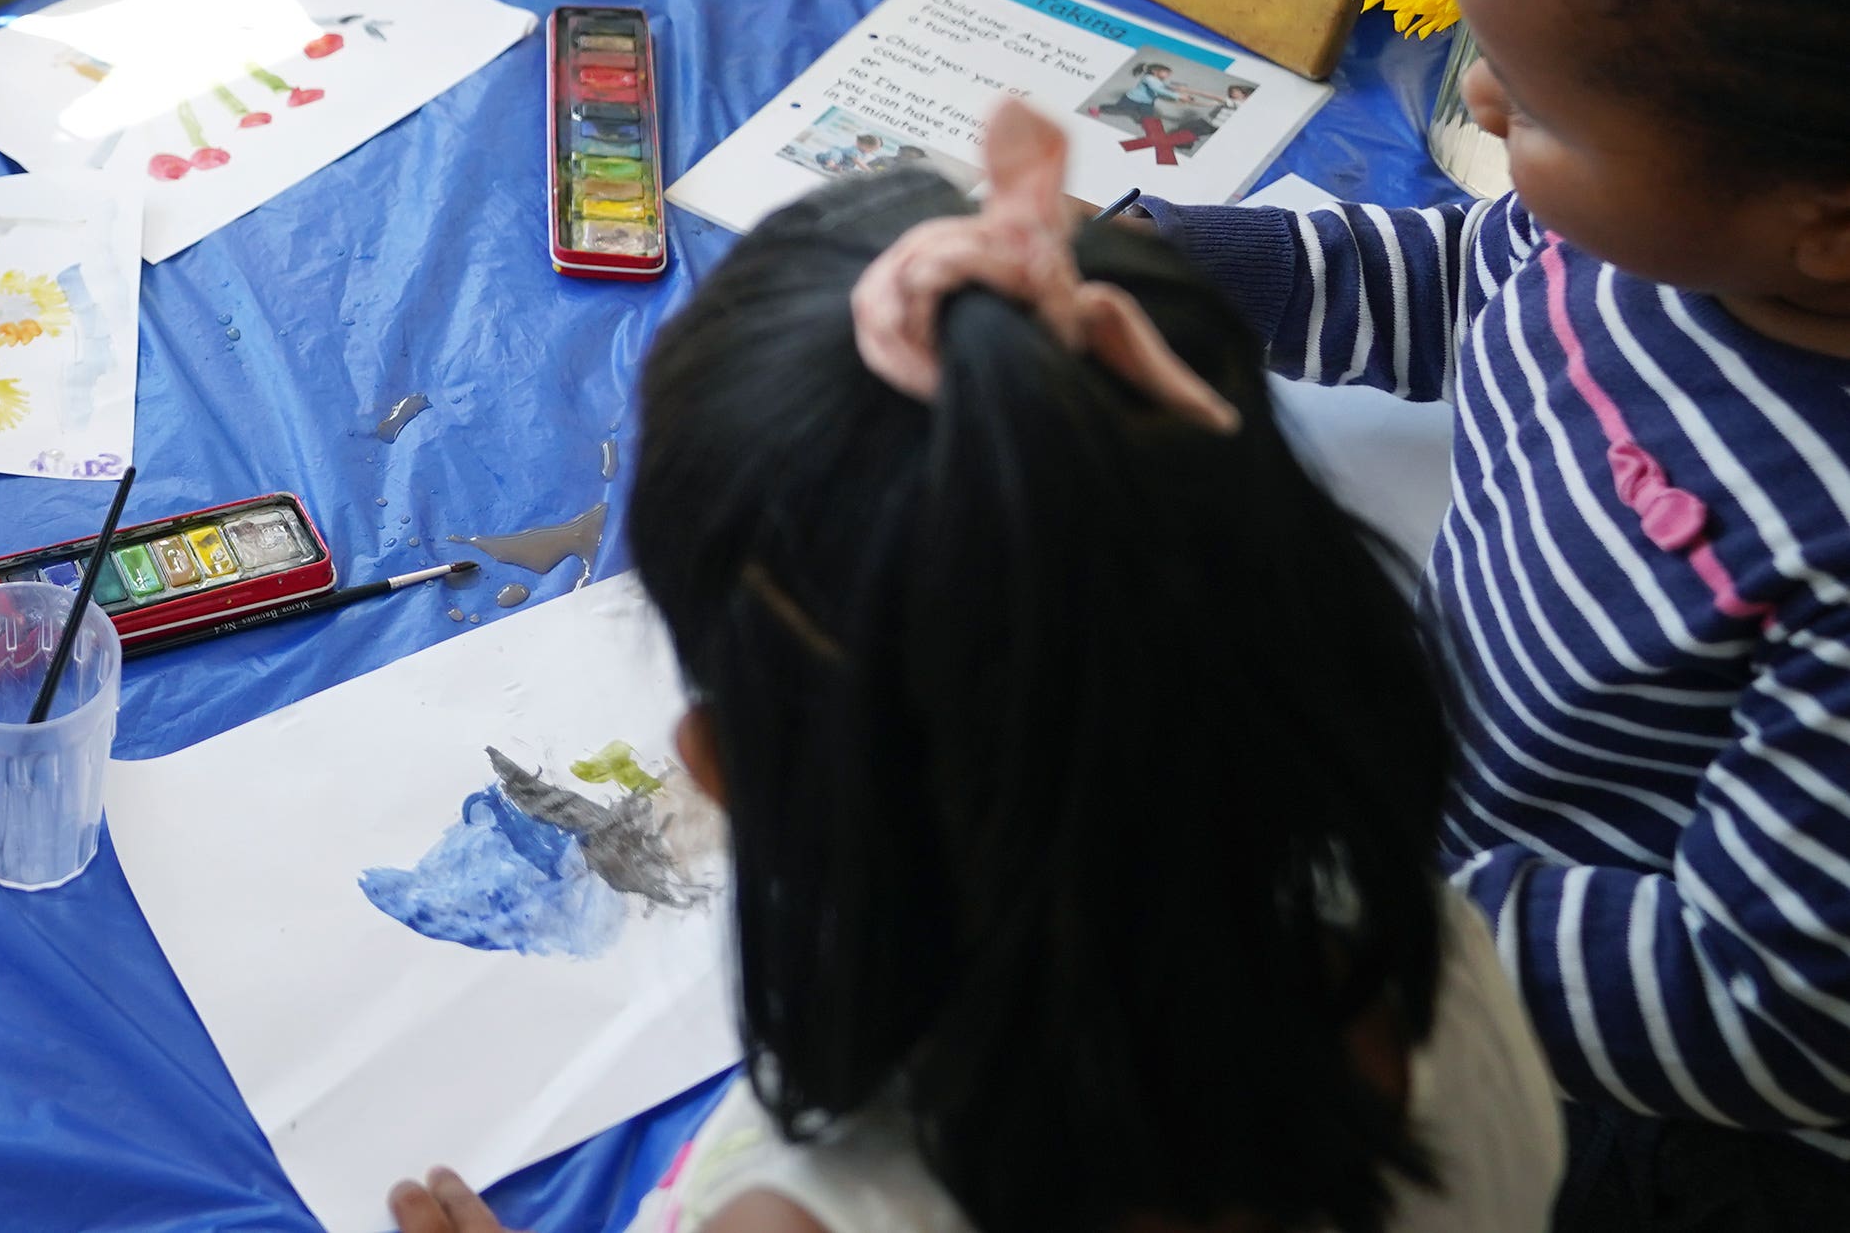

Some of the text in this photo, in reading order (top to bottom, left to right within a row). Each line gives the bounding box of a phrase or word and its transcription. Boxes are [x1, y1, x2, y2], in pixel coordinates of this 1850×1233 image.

[908, 15, 971, 43] a turn?
[920, 4, 1000, 40] finished?
[1003, 39, 1035, 57] Can
[1054, 59, 1096, 82] have
[861, 57, 882, 67] or
[885, 34, 931, 58] Child
[971, 72, 1005, 90] yes
[1018, 32, 1052, 49] Are
[1054, 46, 1088, 64] you
[847, 67, 869, 79] no
[872, 76, 901, 95] I'm
[905, 91, 935, 108] not
[823, 89, 930, 140] in 5 minutes.
[835, 78, 986, 147] you can have a tu
[241, 609, 278, 625] BRUSHES
[282, 600, 311, 614] MAJOR
